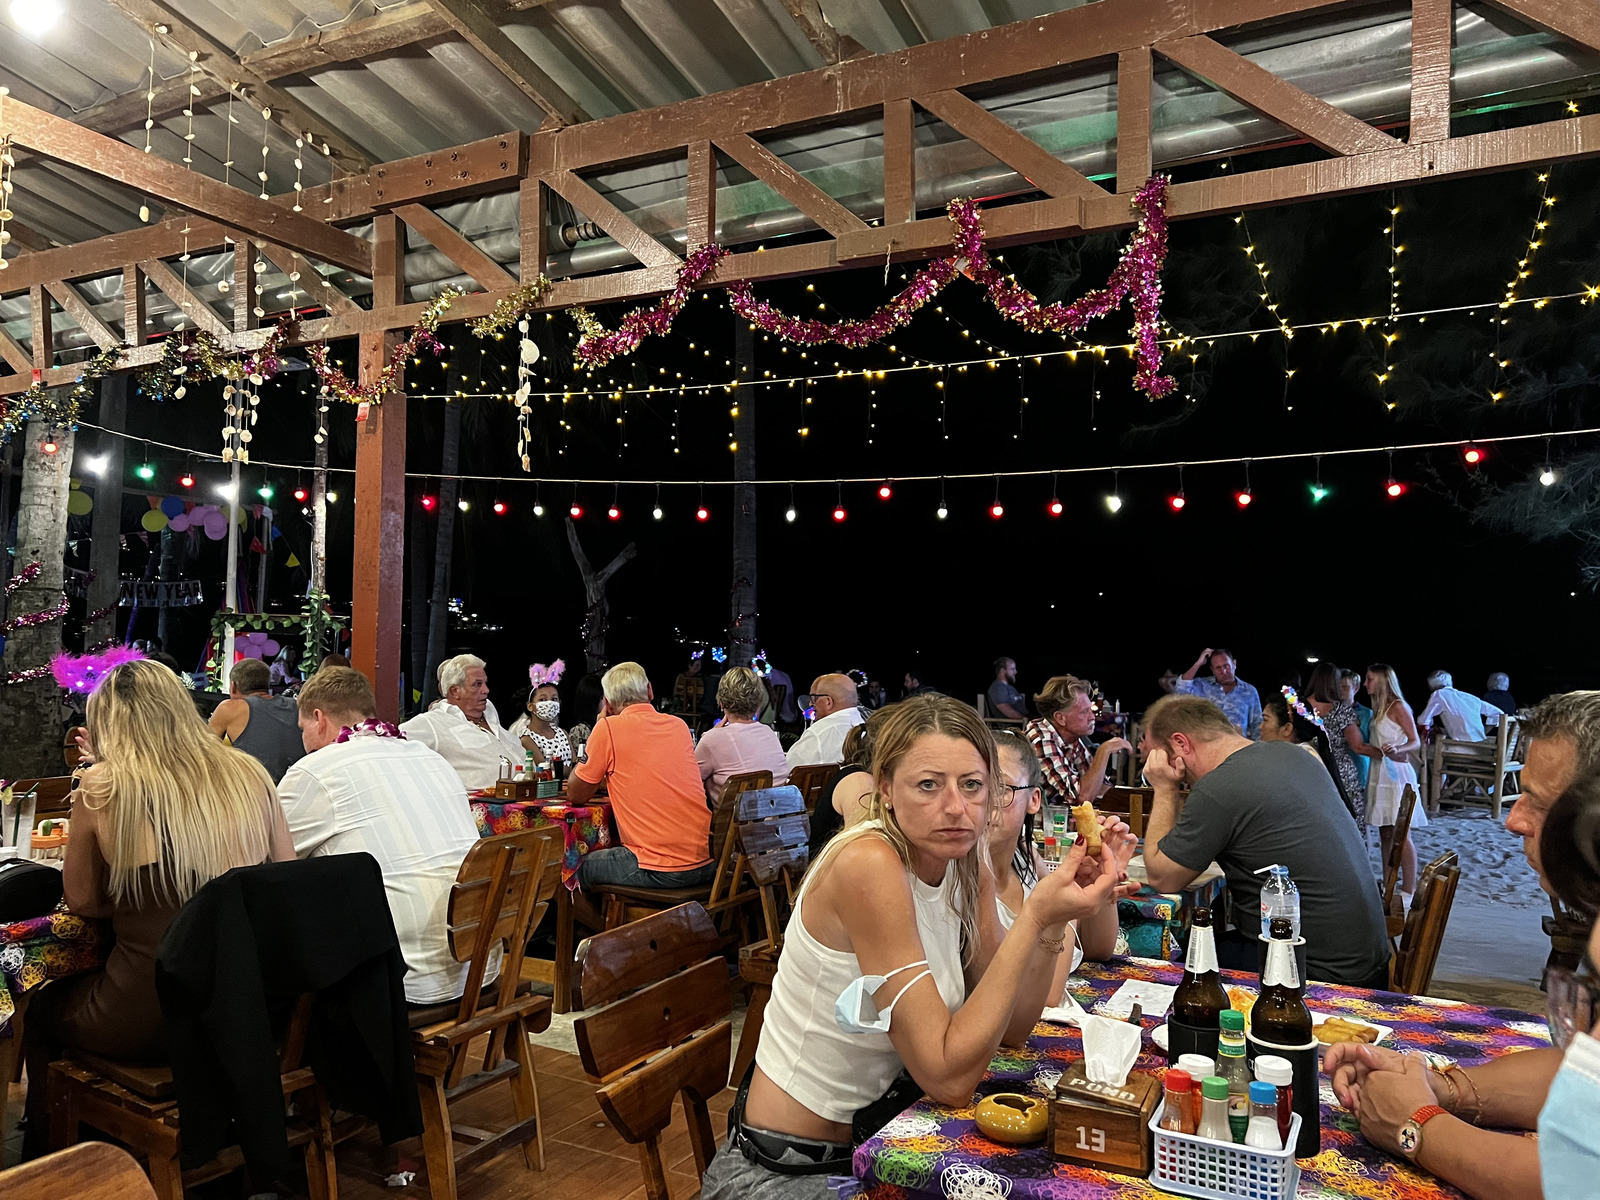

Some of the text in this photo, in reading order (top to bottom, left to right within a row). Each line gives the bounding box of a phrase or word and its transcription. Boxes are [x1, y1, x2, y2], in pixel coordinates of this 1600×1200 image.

[122, 581, 200, 600] NEW YEAR
[1075, 1125, 1106, 1153] 13
